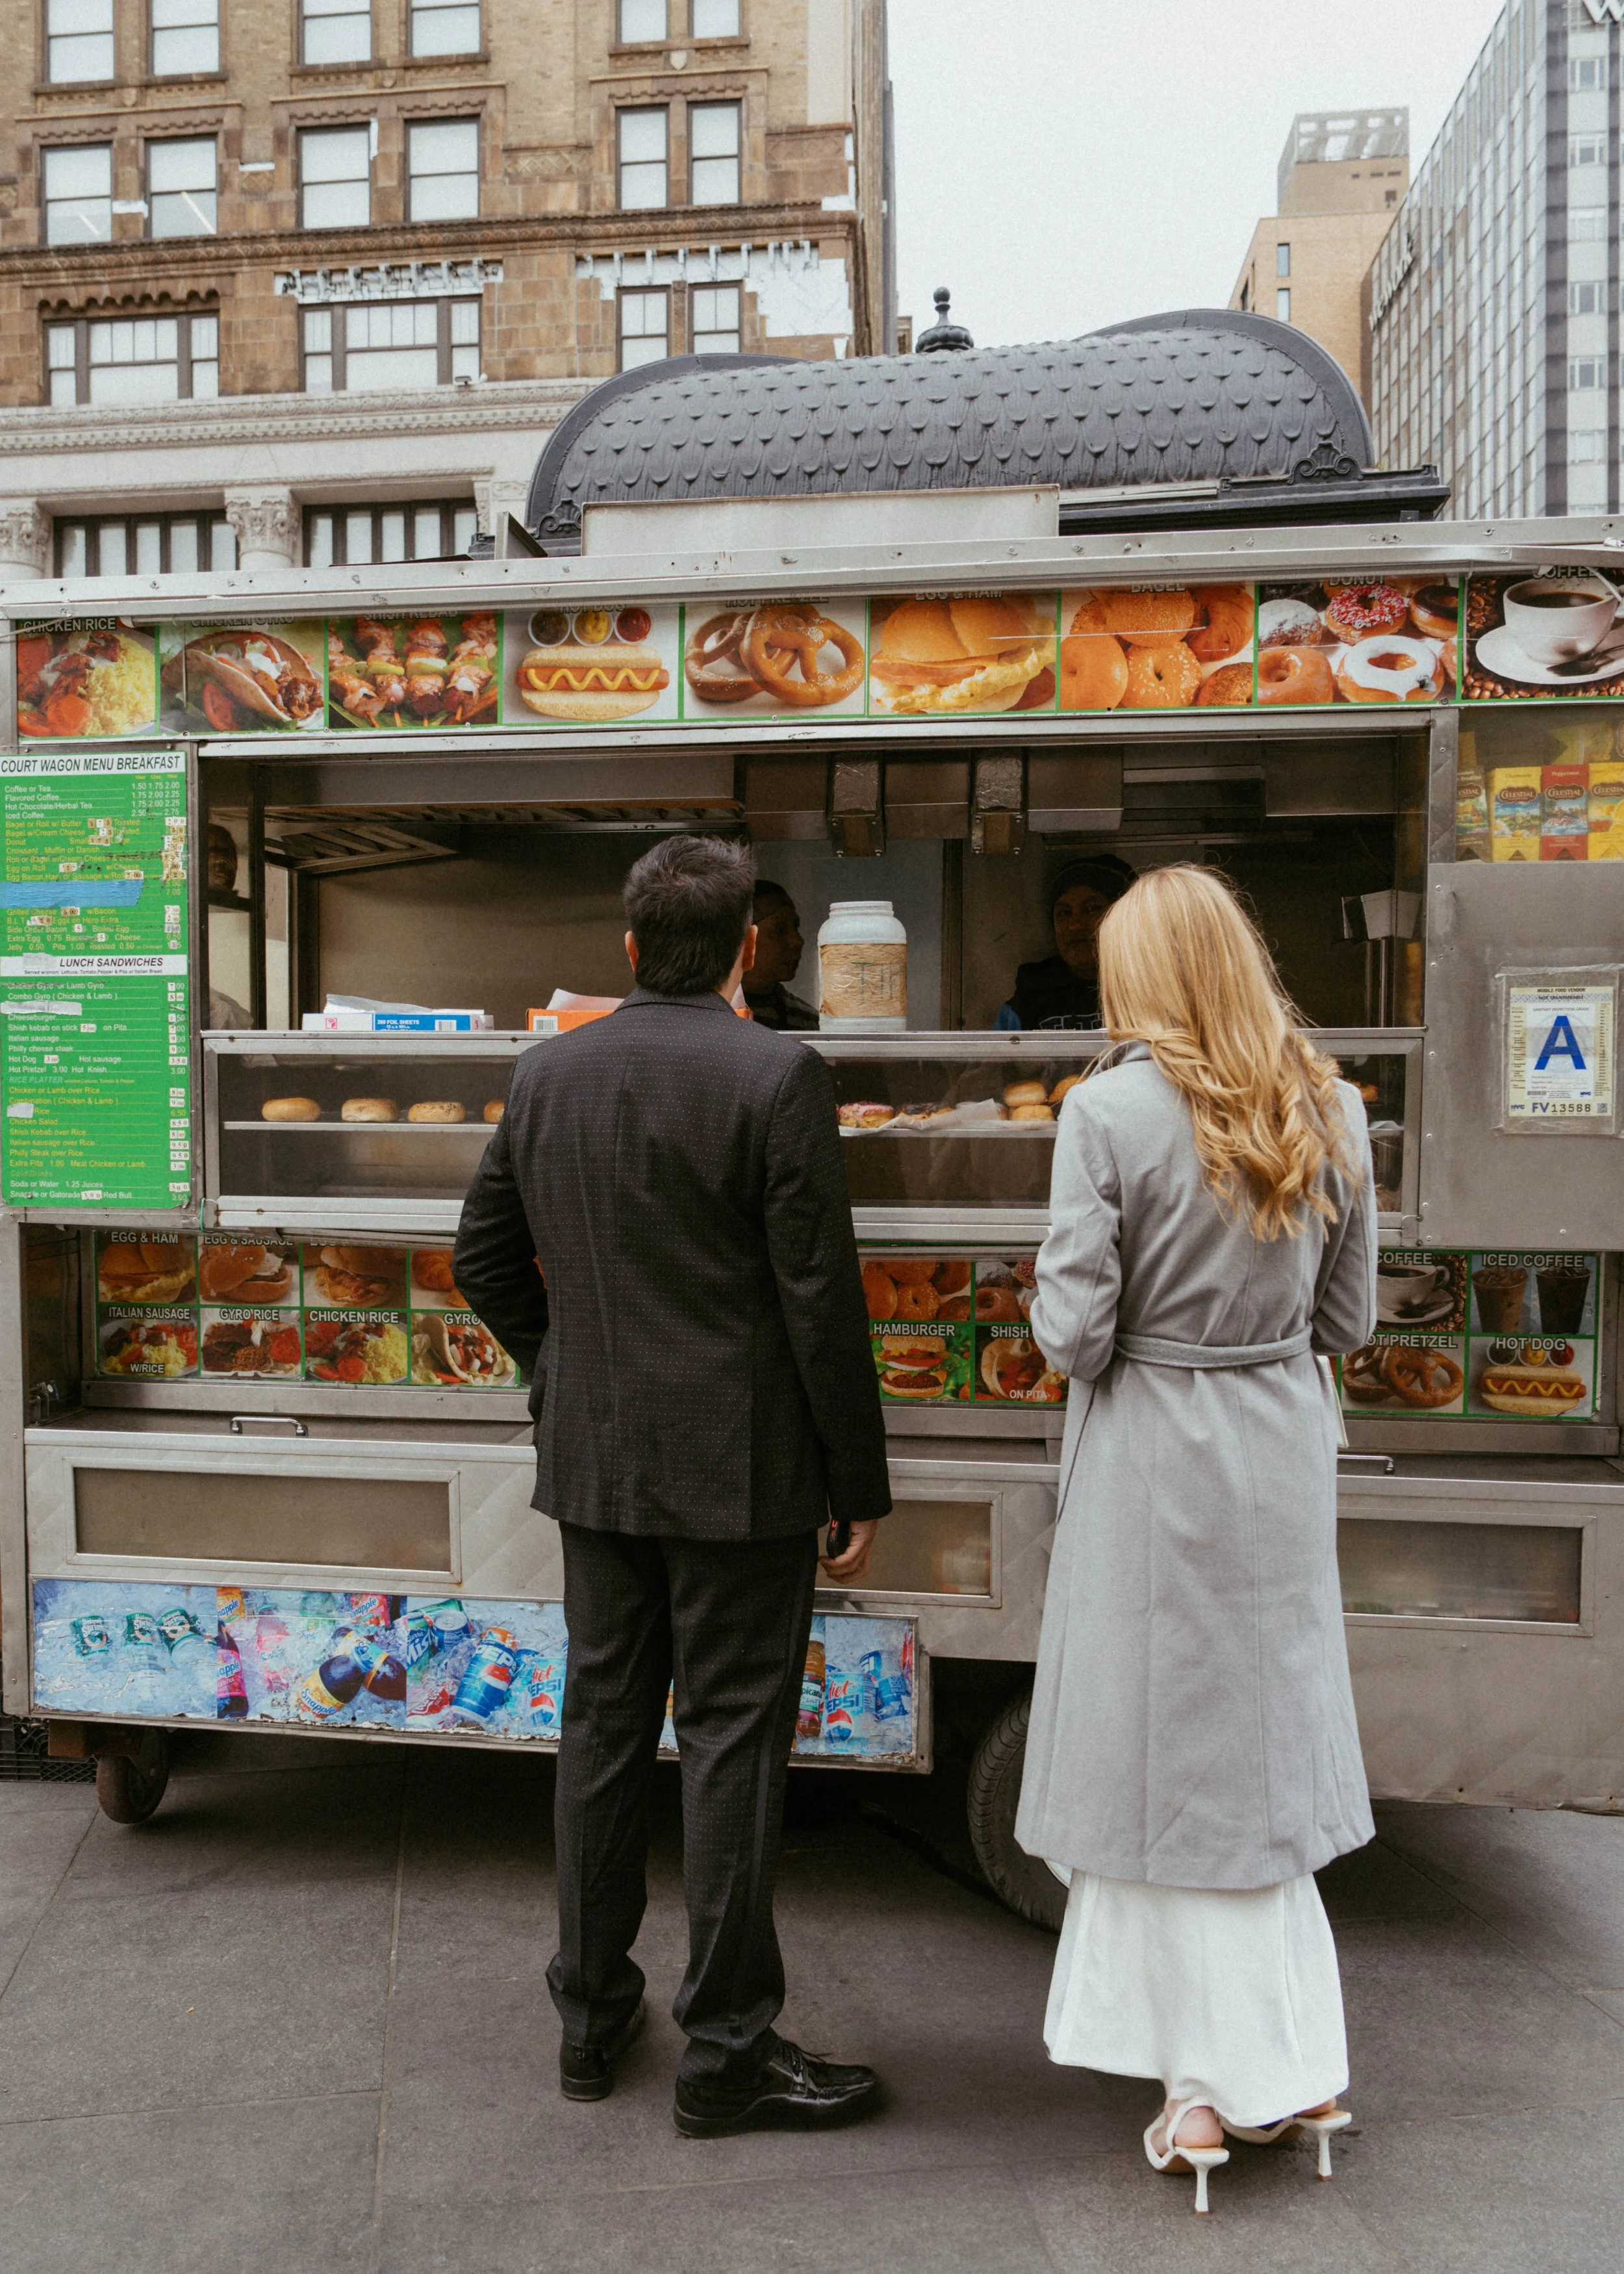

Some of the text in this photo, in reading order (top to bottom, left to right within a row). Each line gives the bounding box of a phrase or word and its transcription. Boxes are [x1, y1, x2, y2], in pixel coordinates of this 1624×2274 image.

[1329, 575, 1384, 586] DONUT
[1131, 583, 1186, 593] BAGEL
[85, 618, 116, 630] RICE
[1, 756, 181, 773] COURT WAGON MENU BREAKFAST
[1500, 790, 1533, 799] CELESTIAL
[1548, 788, 1580, 797] CELESTIAL
[1593, 786, 1624, 795] CELESTIA
[60, 958, 164, 967] LUNCH SANDWICHES
[34, 993, 51, 1001] Gyro
[1534, 1015, 1586, 1070] A
[111, 1232, 179, 1244] EGG & HAM
[205, 1236, 228, 1244] EGG
[1483, 1254, 1584, 1267] ICED COFFEE
[109, 1307, 190, 1319] ITALIAN SAUSAGE
[220, 1309, 279, 1320] GYRO RICE
[309, 1310, 399, 1323] CHICKEN RICE
[444, 1313, 481, 1325] GYRO
[874, 1323, 956, 1336] HAMBURGER
[991, 1325, 1029, 1338] SHISH
[1365, 1334, 1456, 1348] OT PRETZEL
[1496, 1337, 1566, 1351] HOT DOG
[130, 1363, 164, 1373] W/RICE
[1009, 1390, 1047, 1399] ON PITA
[217, 1598, 239, 1616] napple
[531, 1678, 562, 1697] EPSI
[301, 1688, 336, 1715] Snapple
[825, 1694, 859, 1713] EPSI
